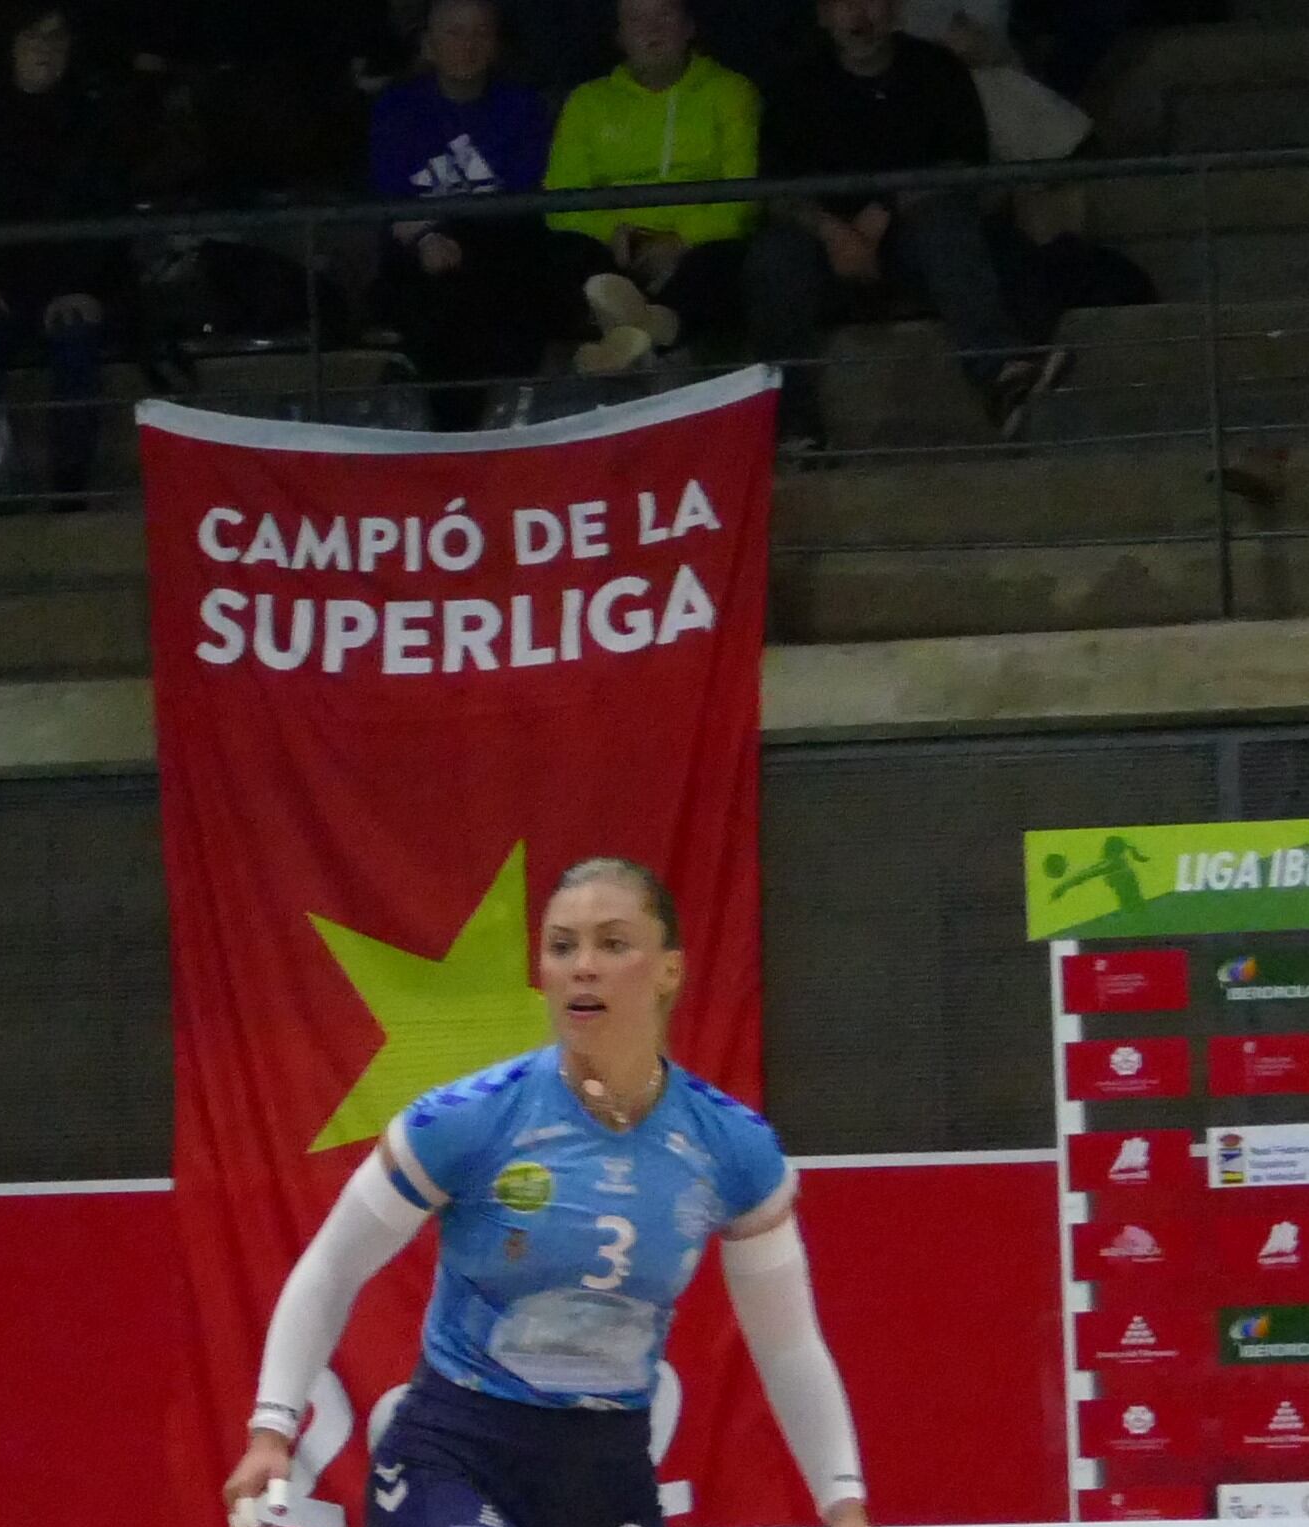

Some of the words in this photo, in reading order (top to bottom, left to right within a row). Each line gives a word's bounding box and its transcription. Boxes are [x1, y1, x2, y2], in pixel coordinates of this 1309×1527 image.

[196, 498, 483, 573] CAMPIÓ
[512, 501, 610, 566] DE
[638, 478, 721, 545] LA
[195, 564, 716, 675] SUPERLIGA
[1175, 851, 1262, 892] LIGA
[1269, 848, 1309, 888] IB
[580, 1215, 637, 1290] 3
